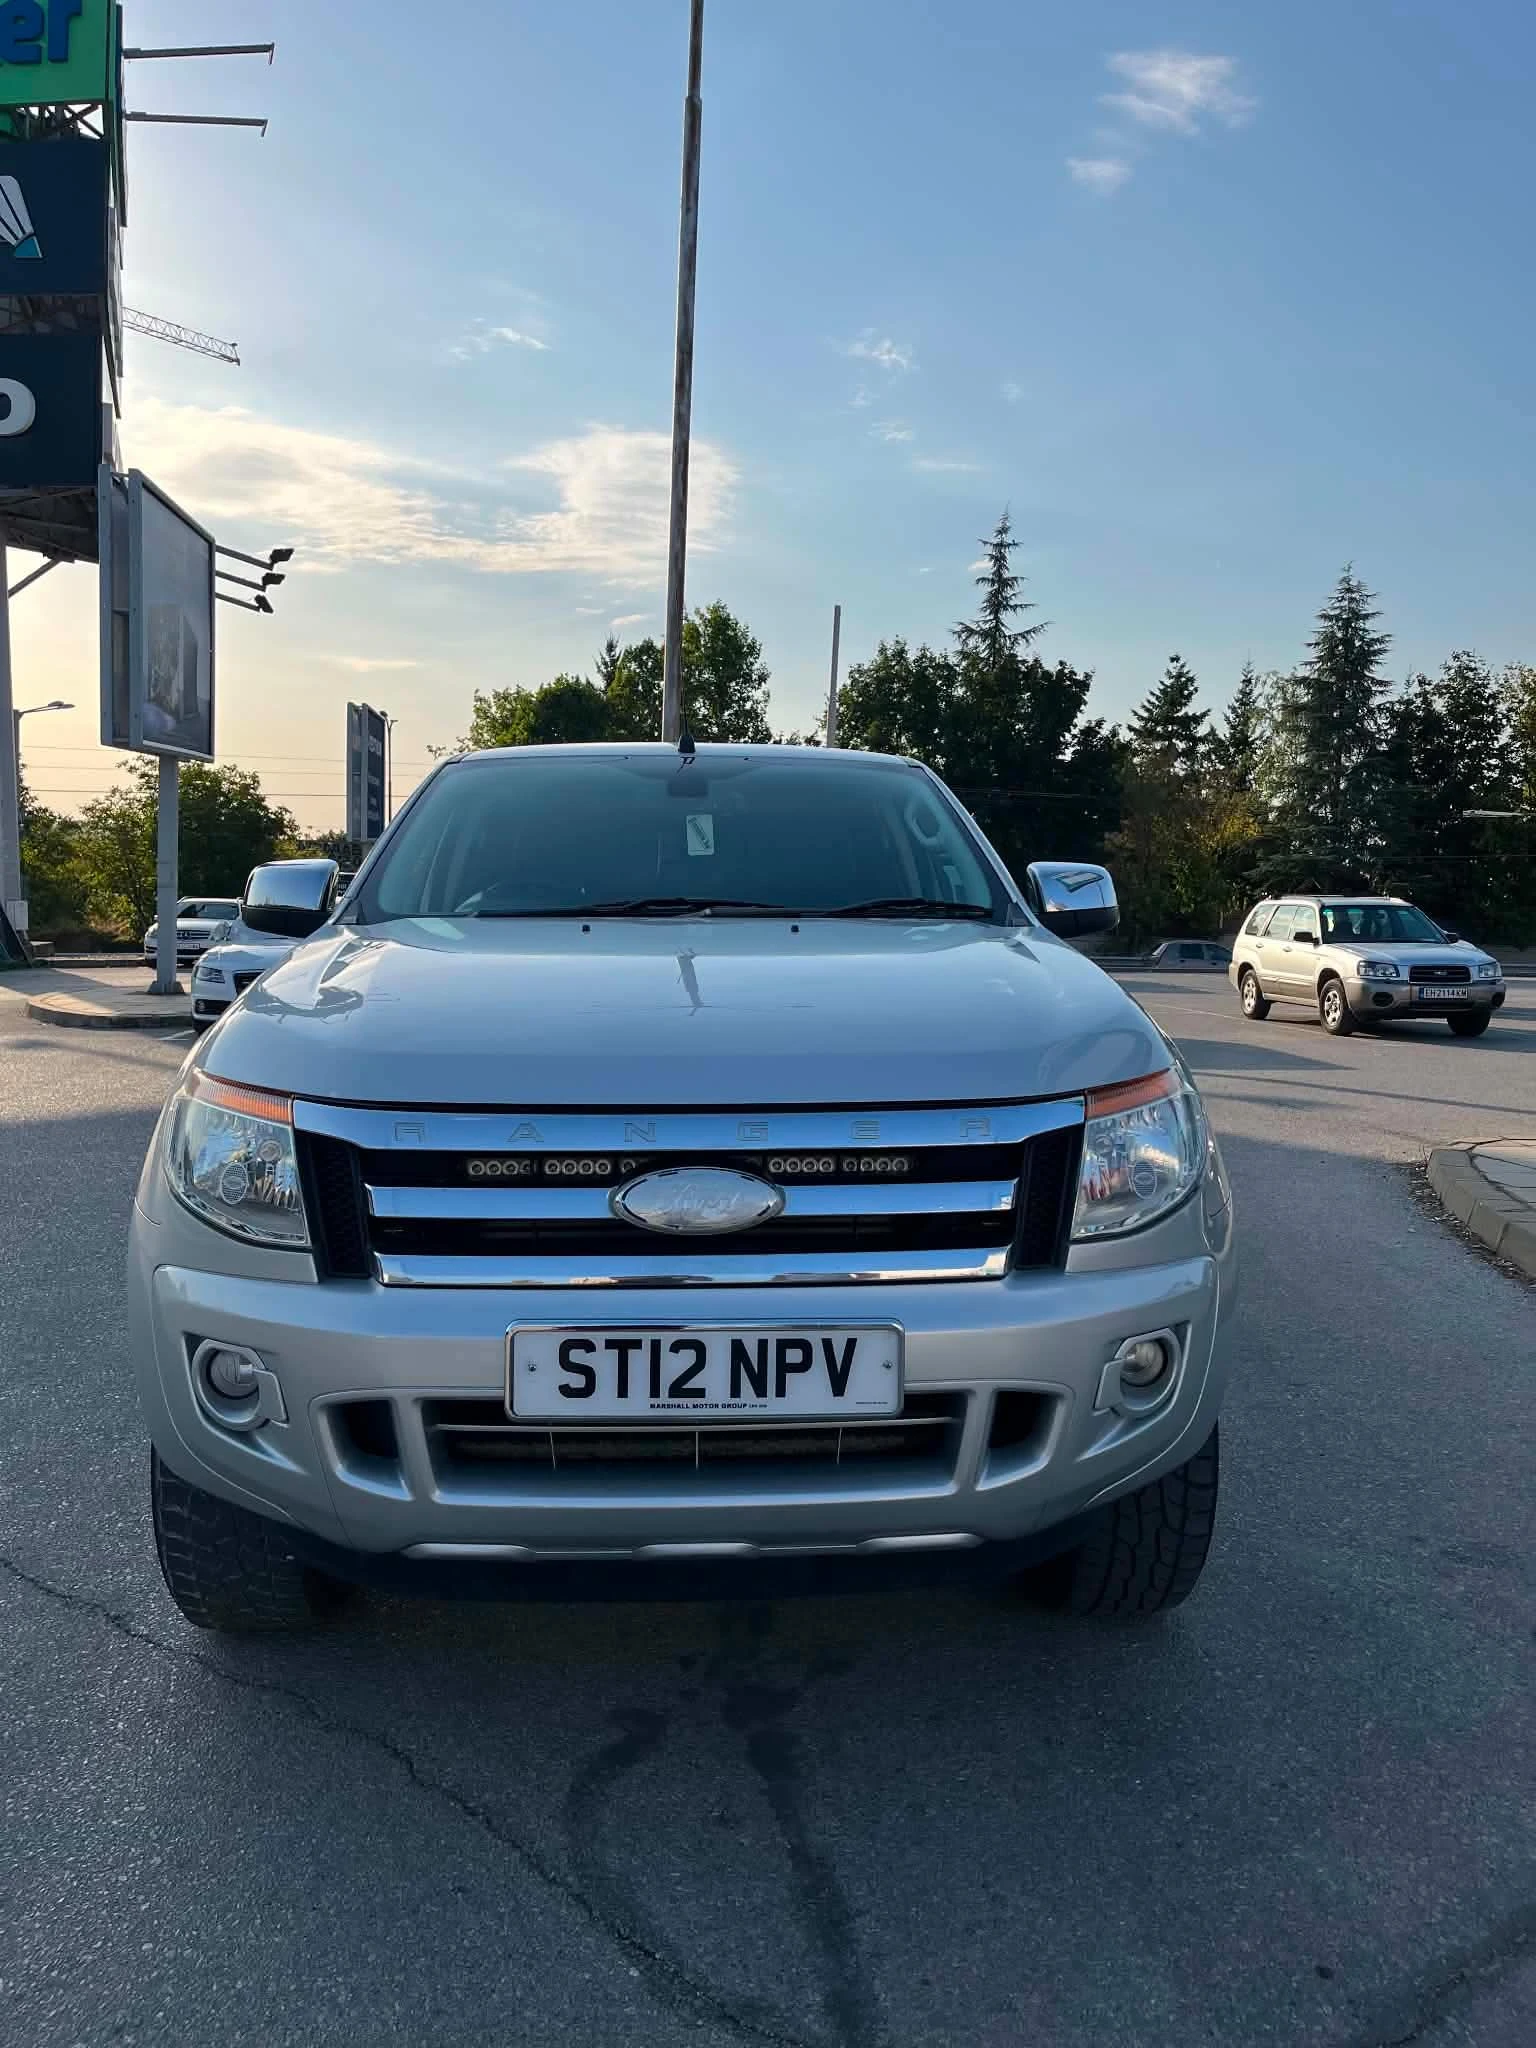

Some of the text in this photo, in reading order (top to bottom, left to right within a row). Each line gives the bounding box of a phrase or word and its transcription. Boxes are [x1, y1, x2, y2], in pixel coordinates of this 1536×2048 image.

[393, 1116, 992, 1143] RANGER
[558, 1338, 858, 1399] ST12 NPV
